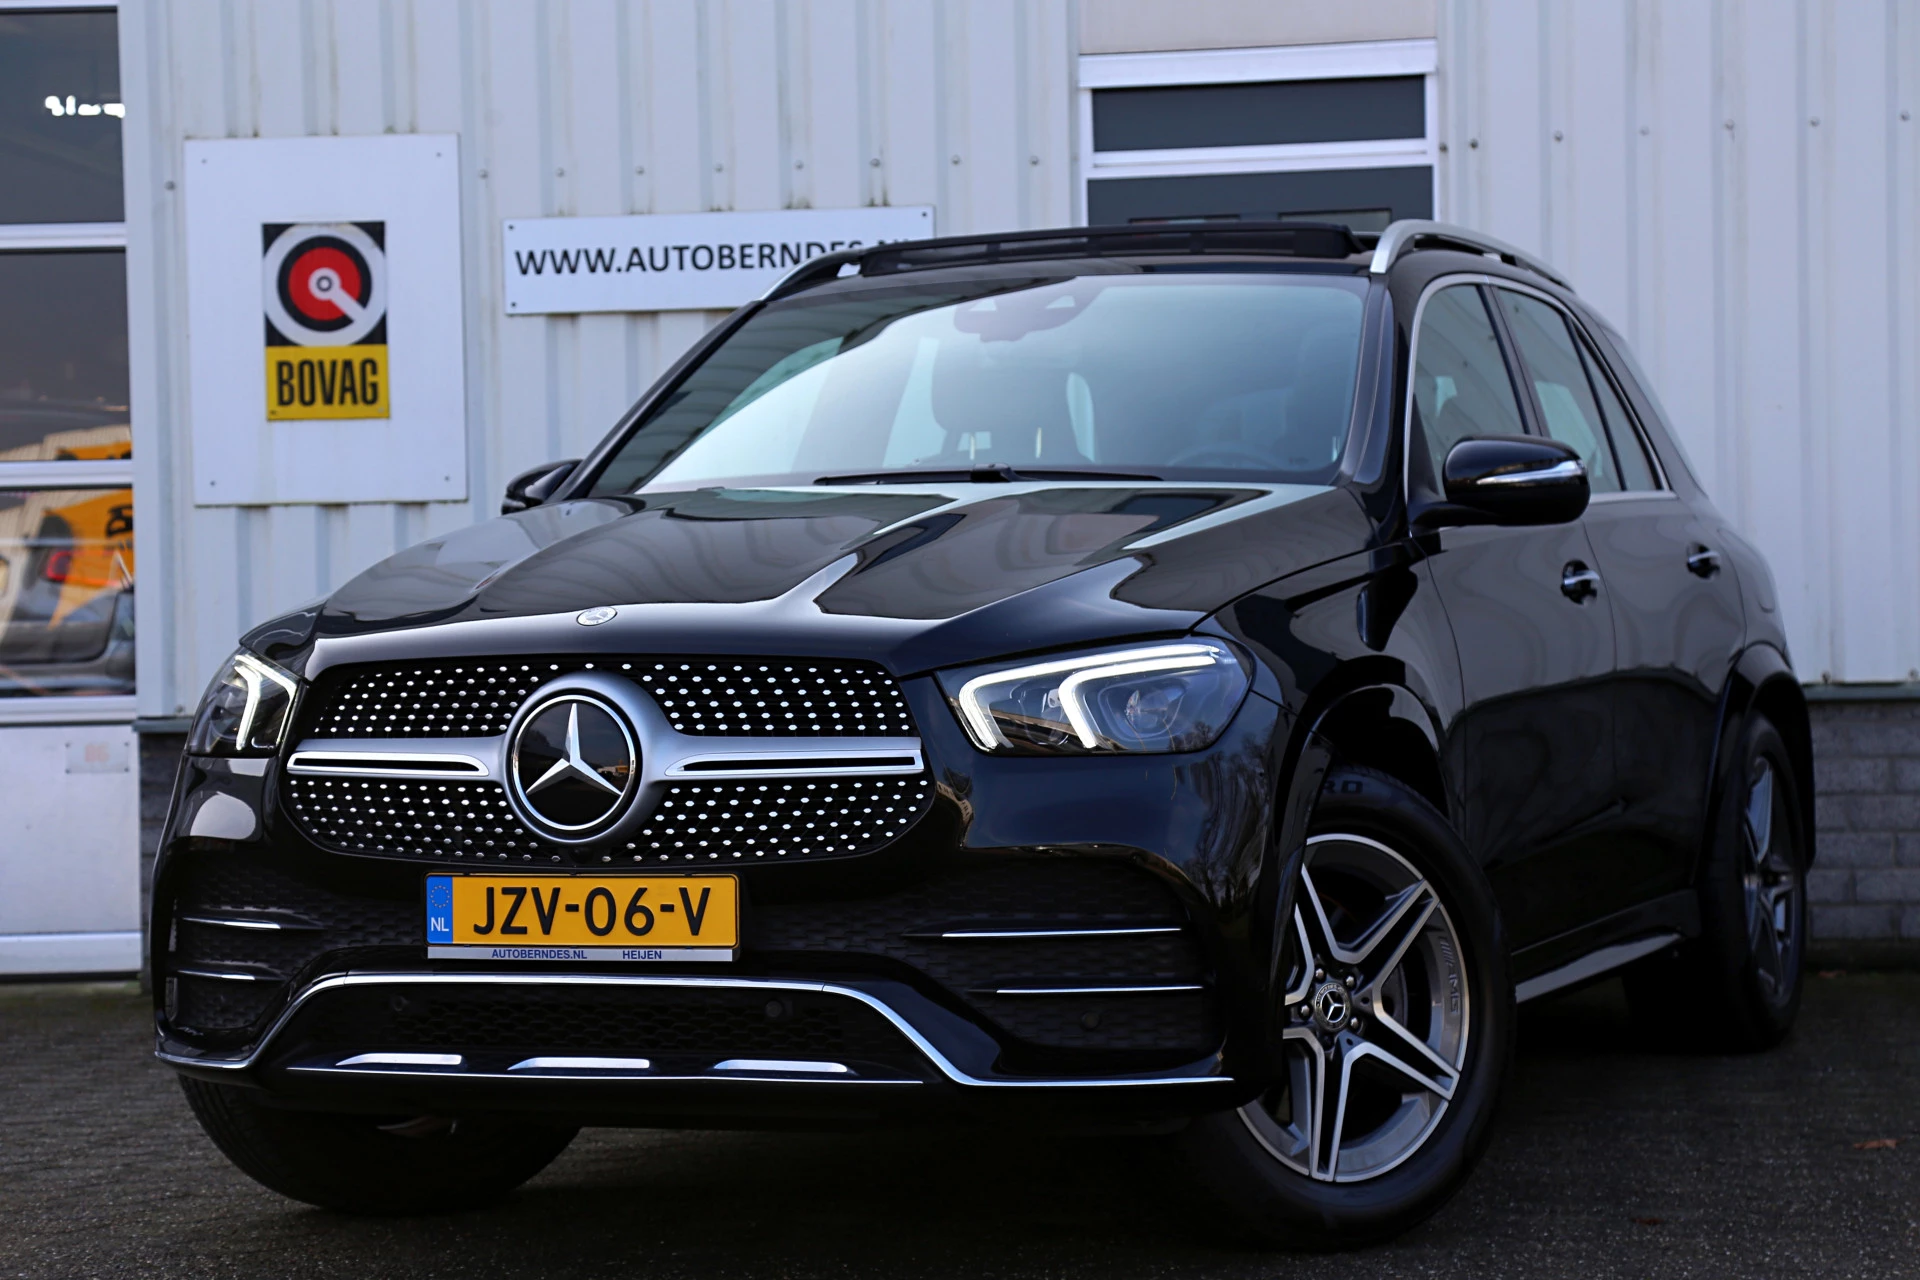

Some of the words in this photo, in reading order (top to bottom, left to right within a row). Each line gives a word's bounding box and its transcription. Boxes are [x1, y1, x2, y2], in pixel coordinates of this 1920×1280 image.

[515, 239, 909, 275] WWW.AUTOBERND
[276, 358, 379, 407] BOVAG
[430, 917, 450, 932] NL
[473, 886, 711, 936] JZV-06-V
[491, 949, 588, 960] AUTOBERNDES.NL
[622, 950, 662, 960] HEIJEN
